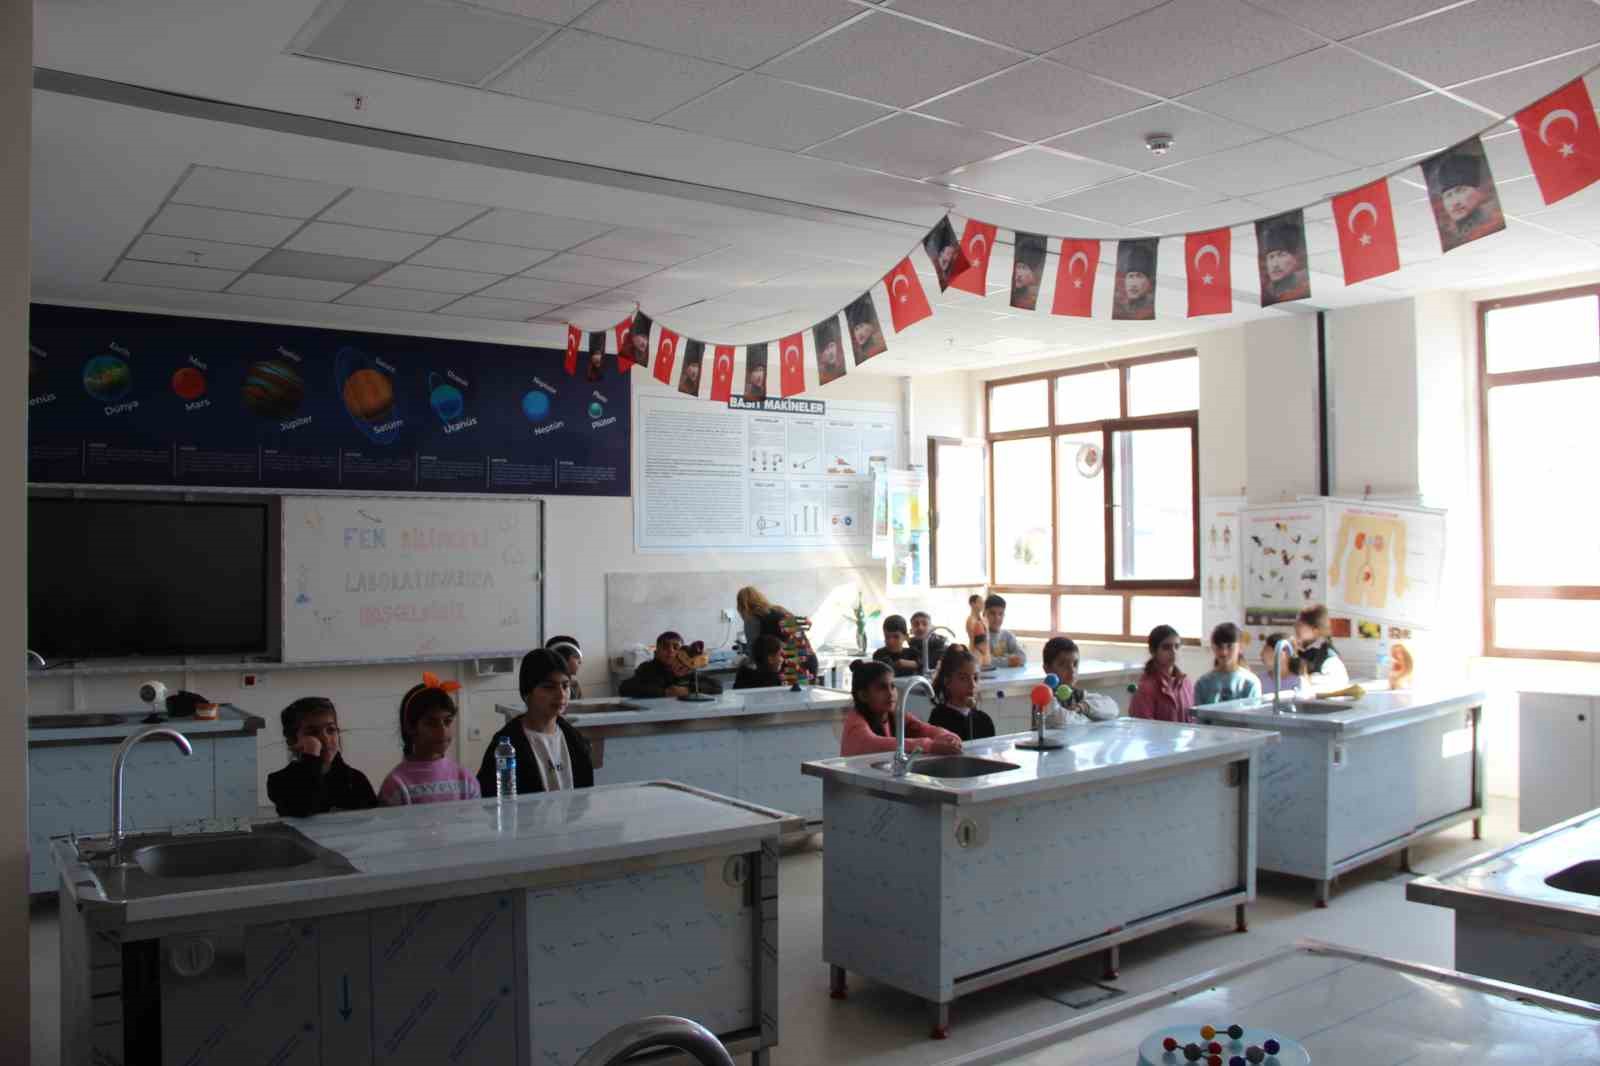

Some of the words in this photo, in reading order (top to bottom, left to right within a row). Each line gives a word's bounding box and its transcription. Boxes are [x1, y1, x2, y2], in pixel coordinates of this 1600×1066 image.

[184, 399, 212, 412] Mars
[763, 398, 825, 415] MAKİNELER
[344, 527, 387, 549] FEN
